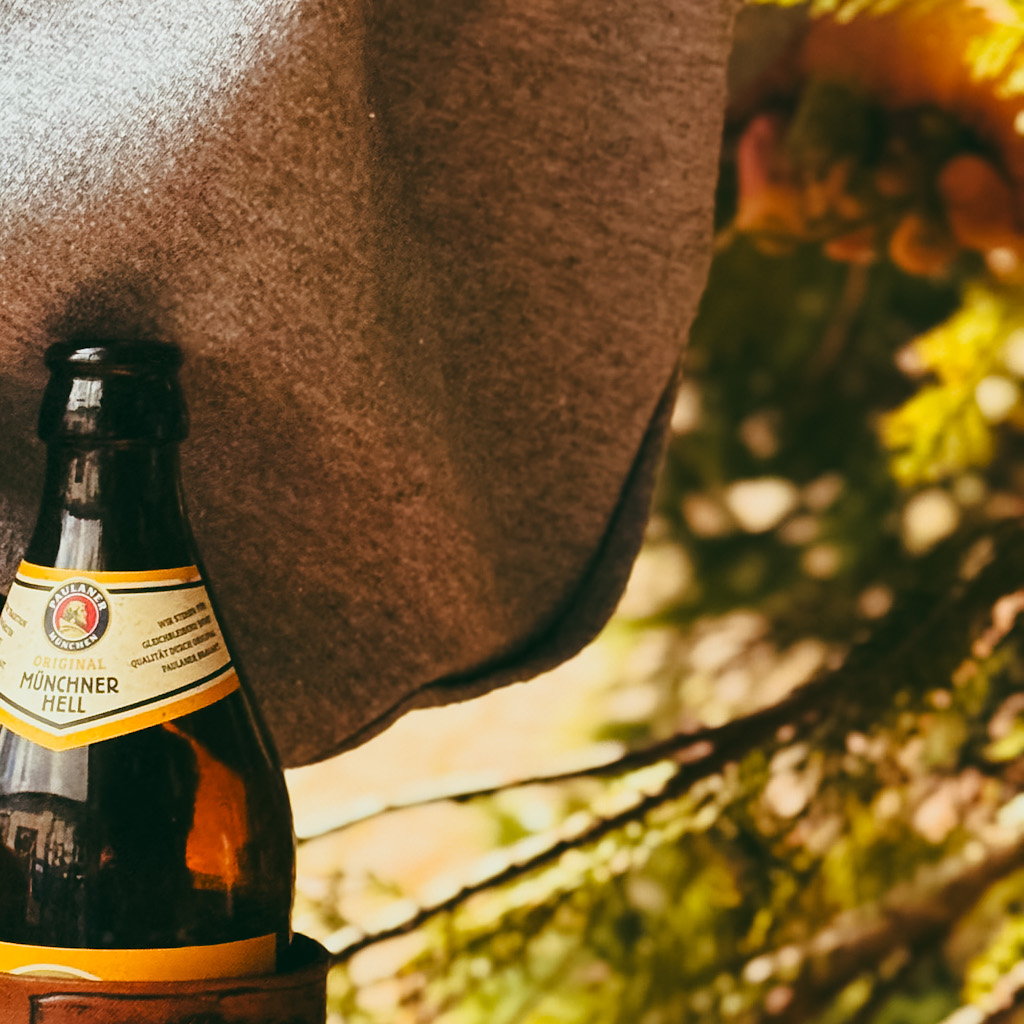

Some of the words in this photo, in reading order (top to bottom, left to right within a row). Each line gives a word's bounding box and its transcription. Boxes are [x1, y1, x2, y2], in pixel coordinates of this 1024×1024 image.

[49, 583, 107, 611] PAULANER
[49, 631, 98, 650] MÜNCHEN
[33, 655, 107, 671] ORIGINAL
[130, 649, 169, 669] QUALITÄT
[19, 670, 119, 694] MÜNCHNER
[41, 694, 86, 713] HELL
